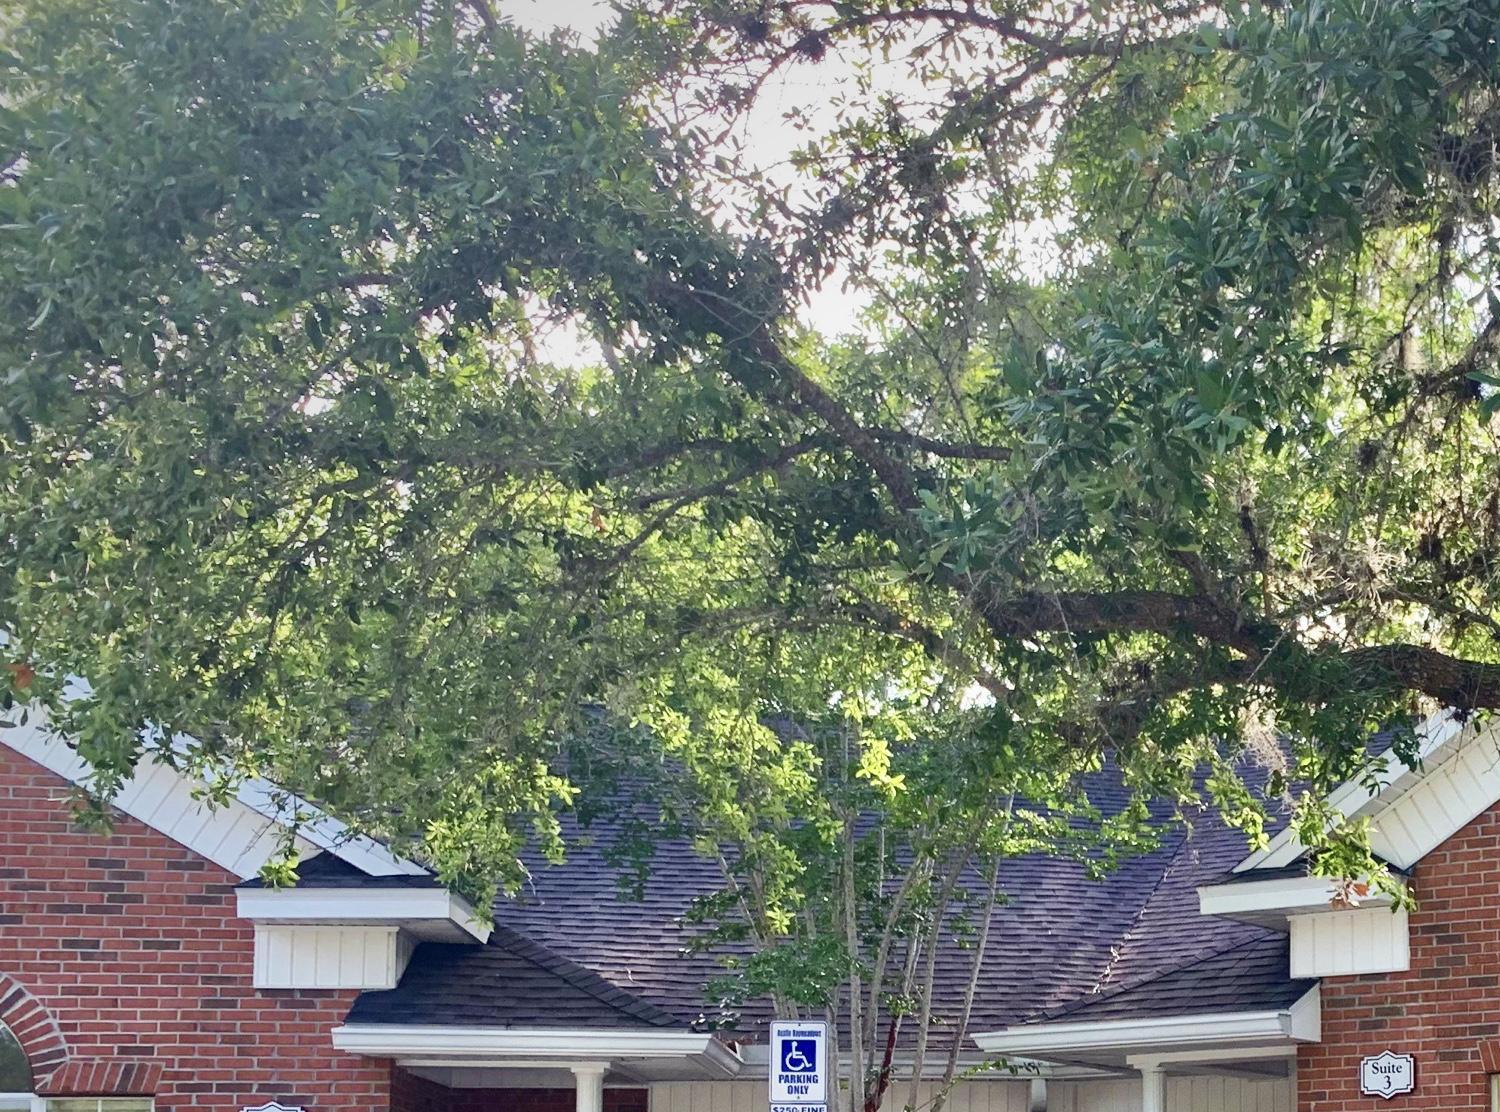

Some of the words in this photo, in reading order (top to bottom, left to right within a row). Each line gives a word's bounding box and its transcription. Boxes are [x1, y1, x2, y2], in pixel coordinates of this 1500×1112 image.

[1371, 1061, 1403, 1074] Suite
[778, 1074, 819, 1084] PARKING
[1383, 1075, 1392, 1090] 3
[787, 1085, 809, 1095] ONLY
